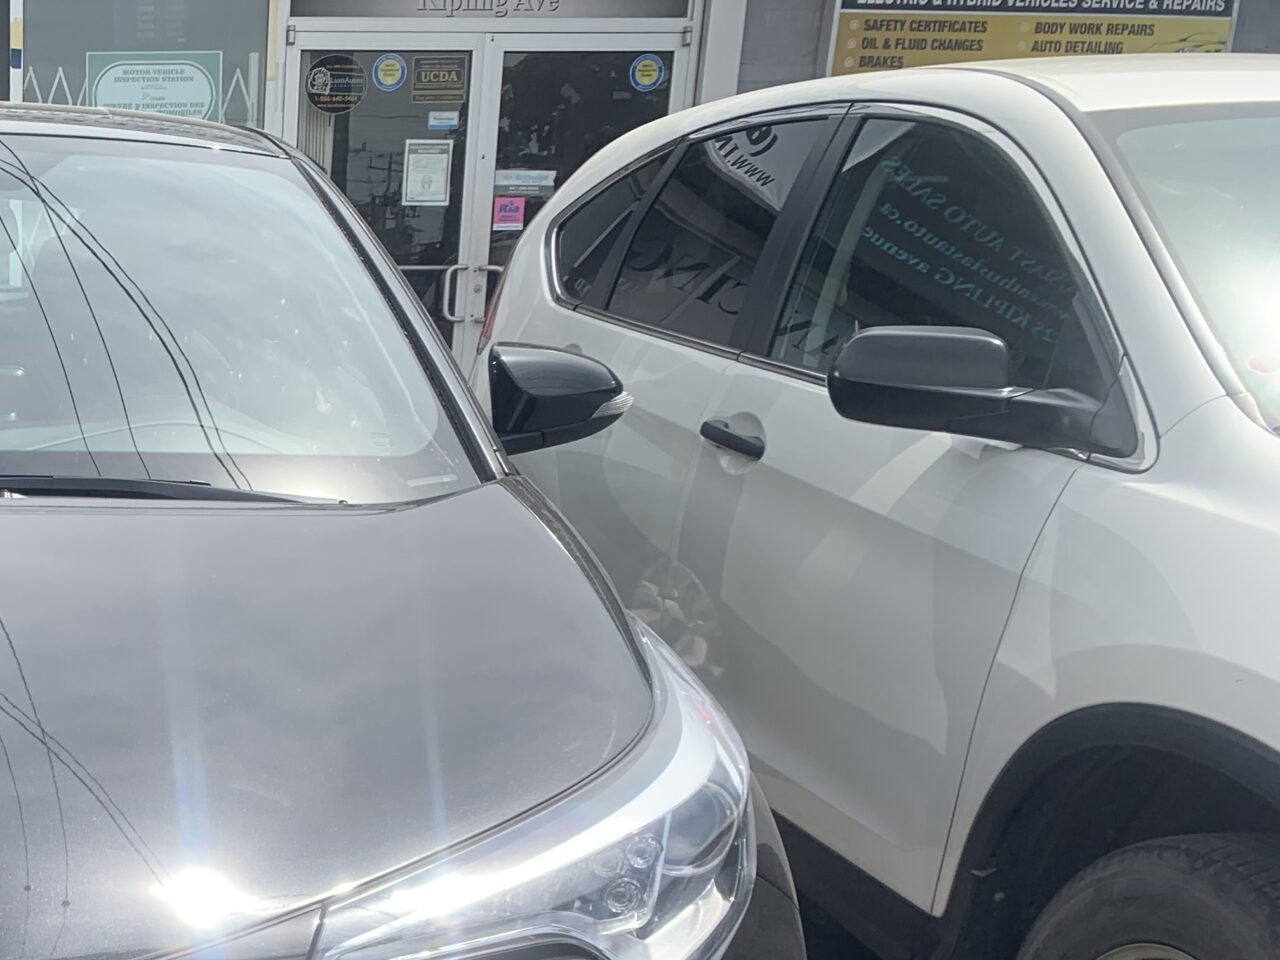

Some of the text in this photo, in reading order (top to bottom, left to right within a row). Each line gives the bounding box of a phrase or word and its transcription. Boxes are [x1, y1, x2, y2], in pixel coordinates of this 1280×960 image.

[1081, 0, 1144, 9] SERVICE
[1162, 0, 1226, 12] REPAIRS
[864, 19, 988, 34] SAFETY CERTIFICATES
[1034, 22, 1155, 36] BODY WORK REPAIRS
[861, 37, 984, 51] OIL & FLUID CHANGES
[1031, 41, 1124, 54] AUTO DETAILING
[858, 56, 904, 69] BRAKES
[421, 71, 458, 82] UCDA
[499, 201, 520, 213] Ria
